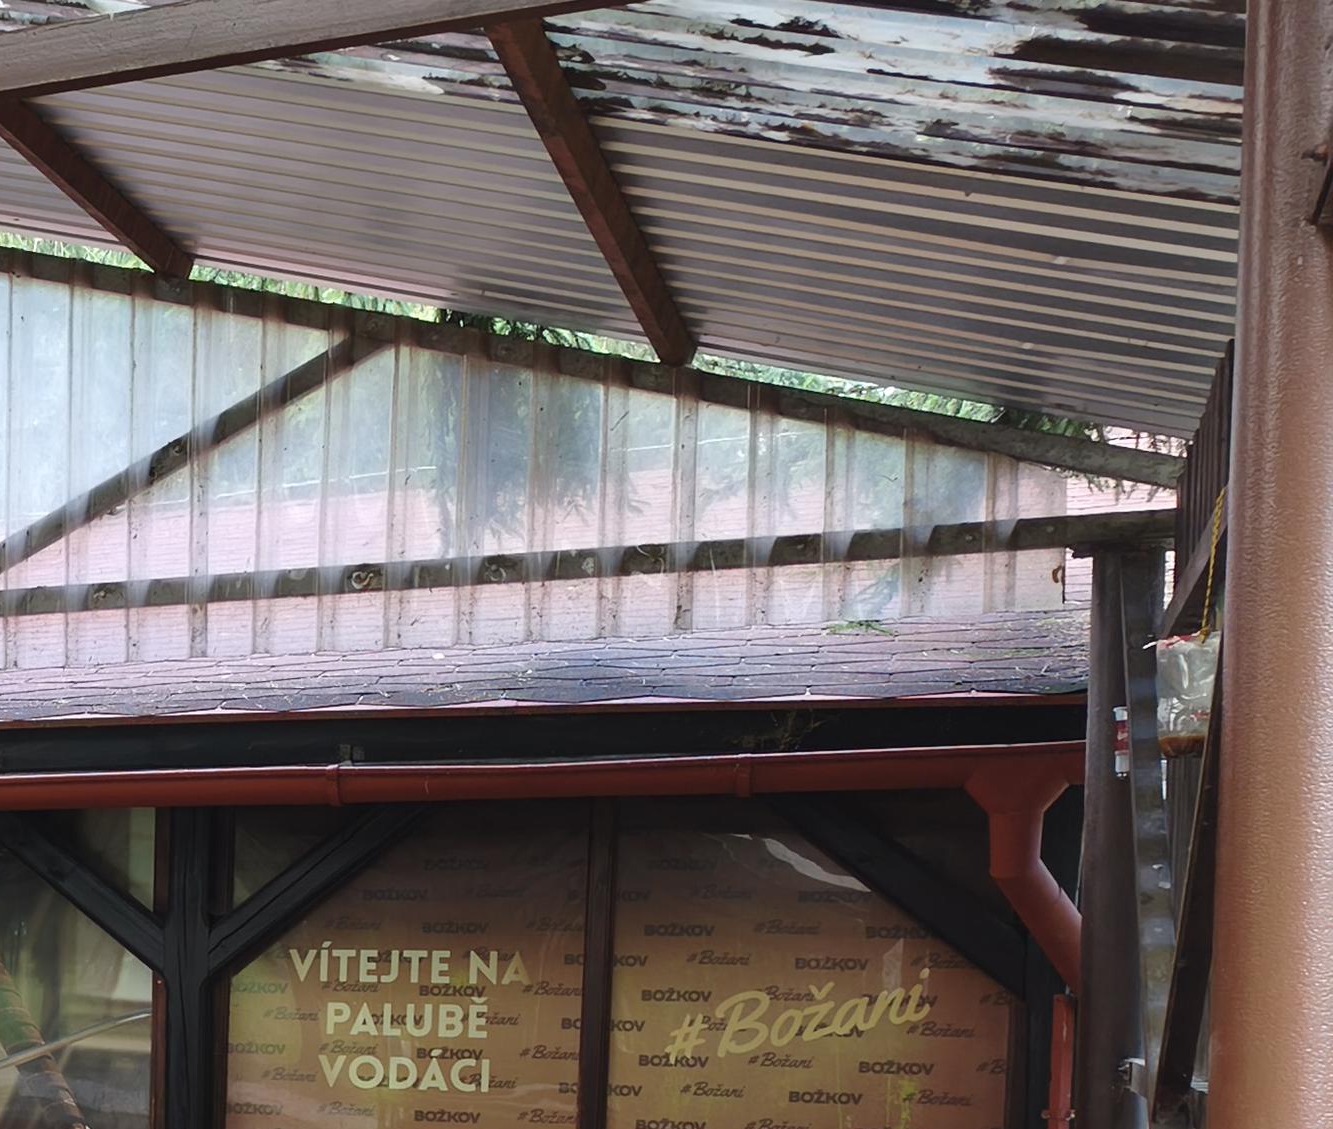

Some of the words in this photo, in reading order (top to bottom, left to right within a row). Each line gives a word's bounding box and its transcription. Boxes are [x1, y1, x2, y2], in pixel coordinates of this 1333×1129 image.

[288, 940, 452, 984] VÍTEJTE
[469, 950, 531, 985] NA
[640, 988, 713, 1004] BOŽKOV
[325, 996, 489, 1039] PALUBĚ
[663, 965, 935, 1064] #Božani
[318, 1049, 492, 1093] VODÁCI
[857, 1059, 934, 1077] BOŽKOV
[787, 1089, 864, 1107] BOŽKOV
[413, 1108, 481, 1124] BOŽKOV
